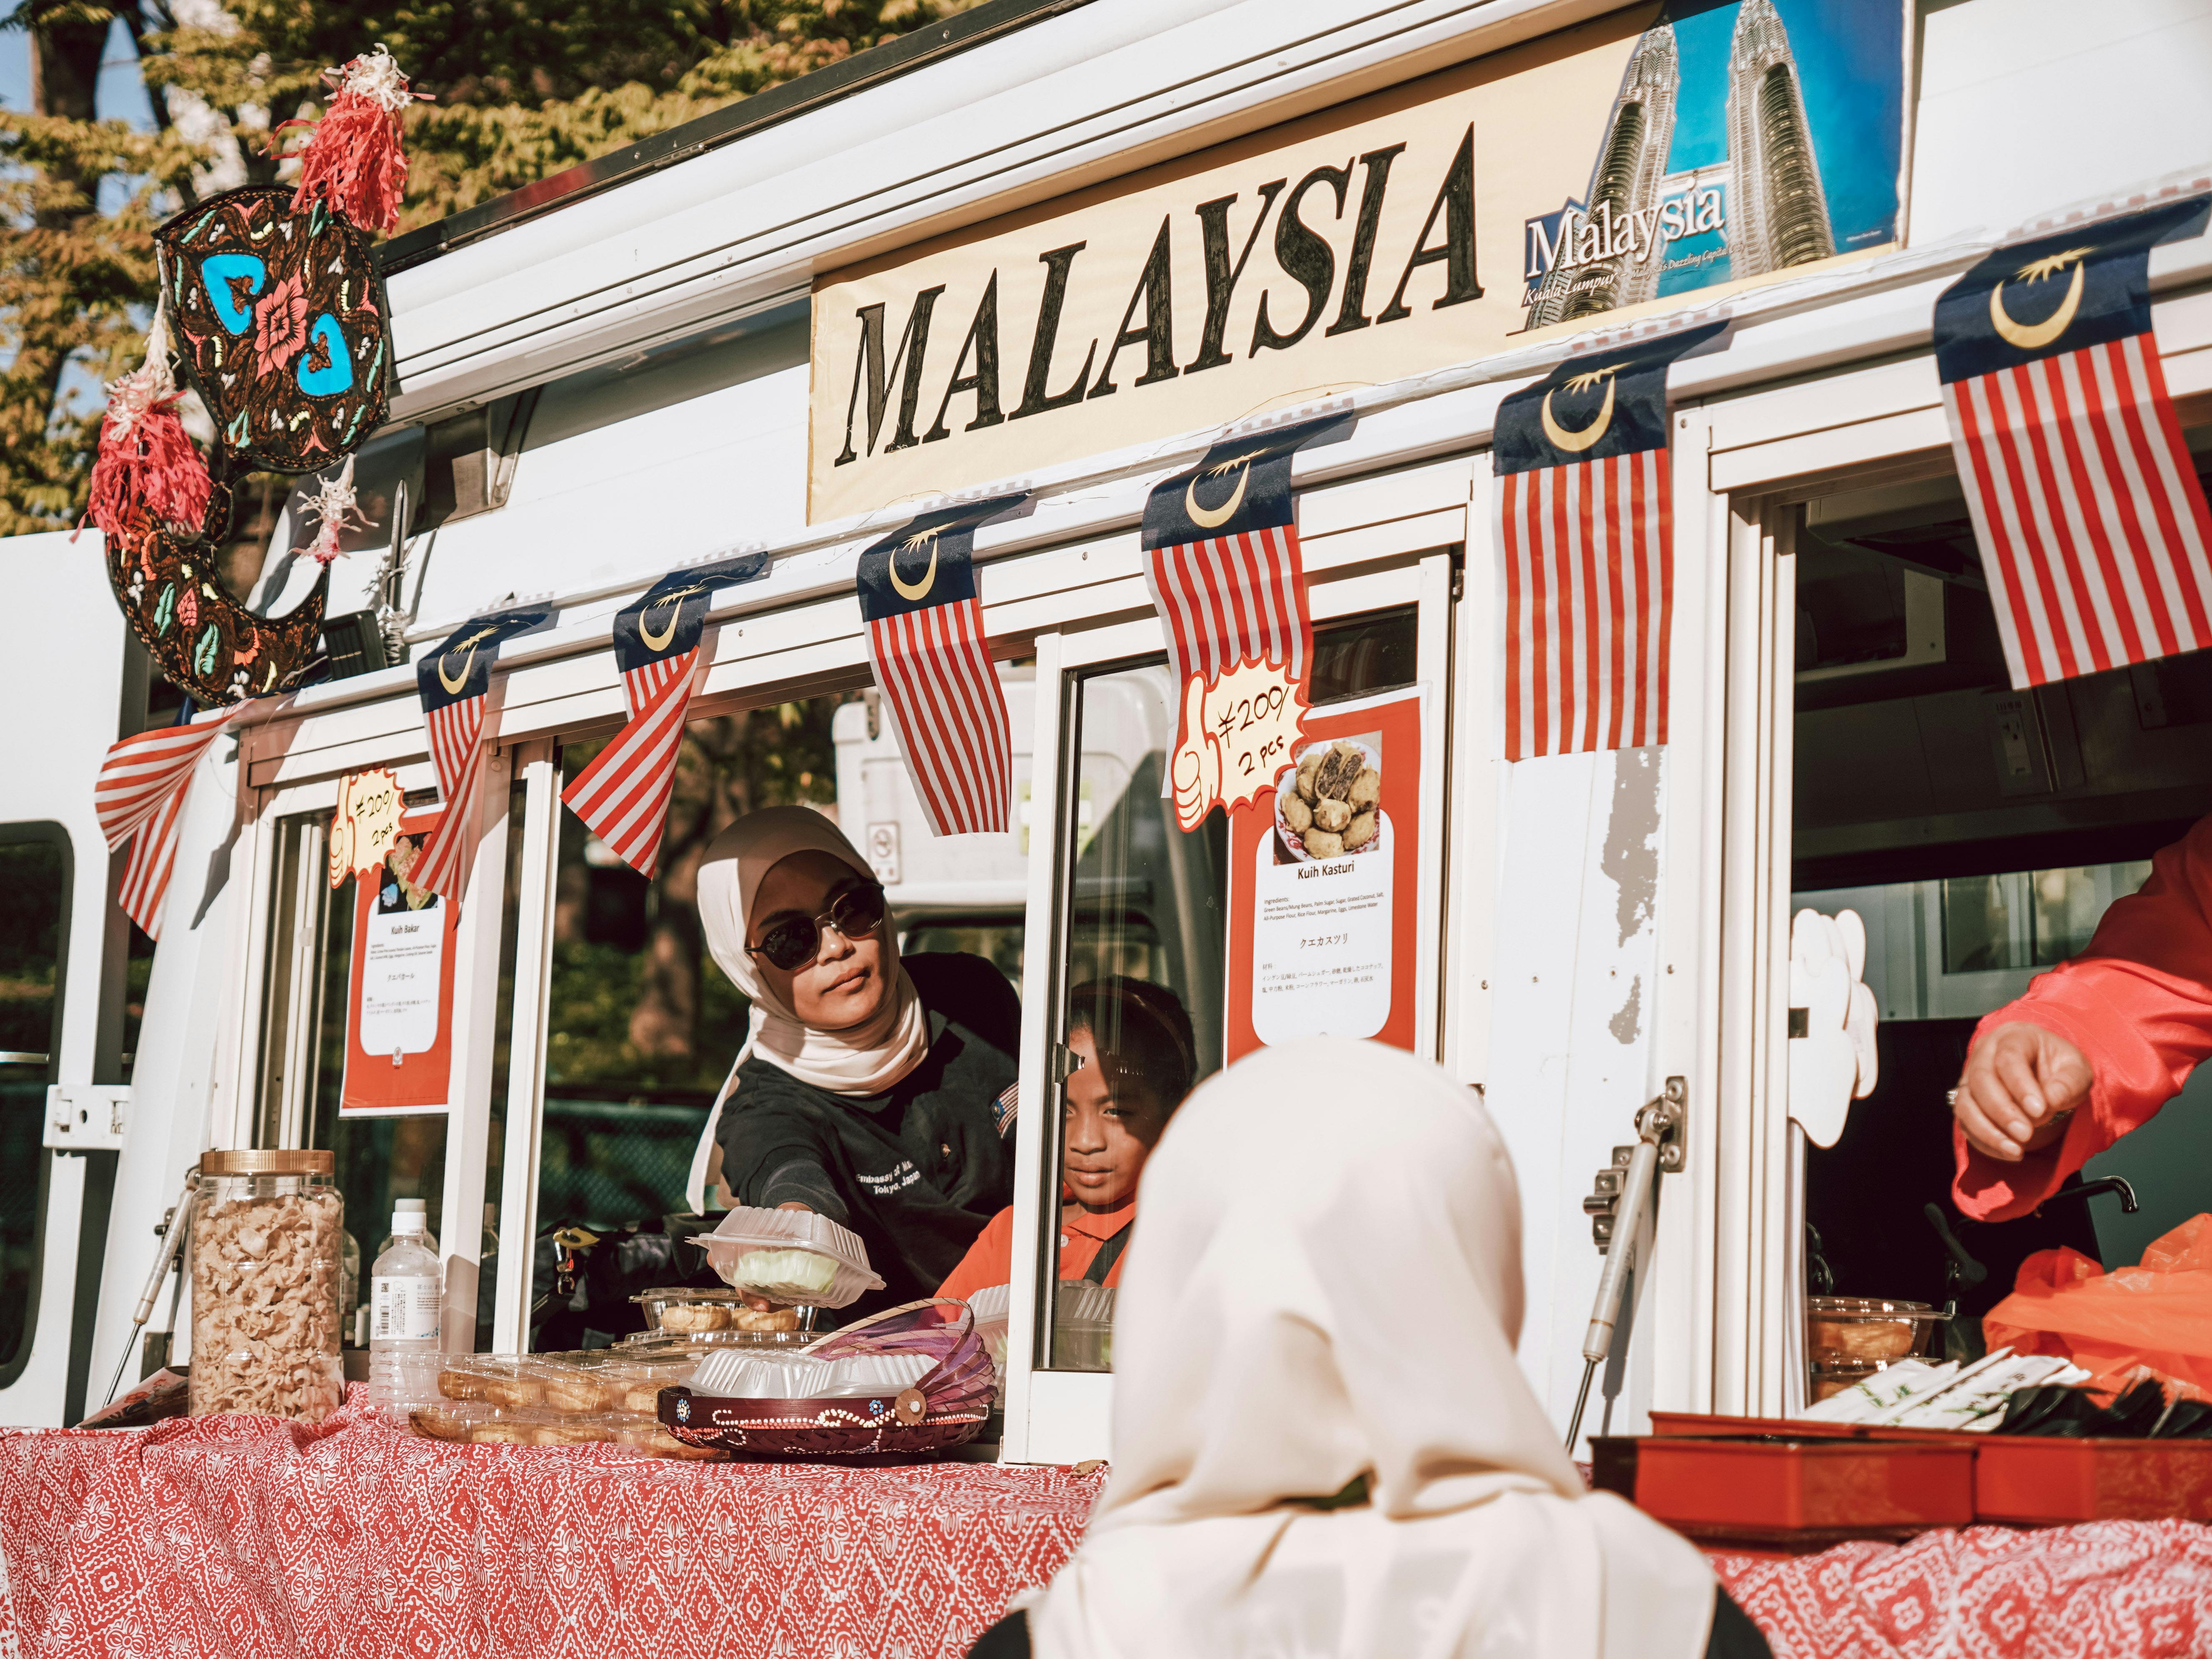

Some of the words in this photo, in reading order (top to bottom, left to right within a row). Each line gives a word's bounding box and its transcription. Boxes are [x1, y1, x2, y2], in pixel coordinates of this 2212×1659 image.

[1526, 177, 1725, 278] Malaysia
[1524, 280, 1561, 305] Kuala
[1563, 272, 1617, 296] Lumpur
[1669, 253, 1702, 267] Dazzling
[1702, 245, 1729, 263] Capital
[835, 121, 1485, 467] MALAYSIA
[1239, 752, 1255, 776] 2
[1260, 735, 1284, 768] pcs
[1298, 866, 1319, 879] Kuih
[1322, 860, 1354, 876] Kasturi
[391, 925, 403, 935] Kuih
[404, 924, 420, 933] Bakar
[1300, 933, 1348, 949] クエカスツリ
[894, 1164, 900, 1176] of
[902, 1171, 921, 1186] Japan
